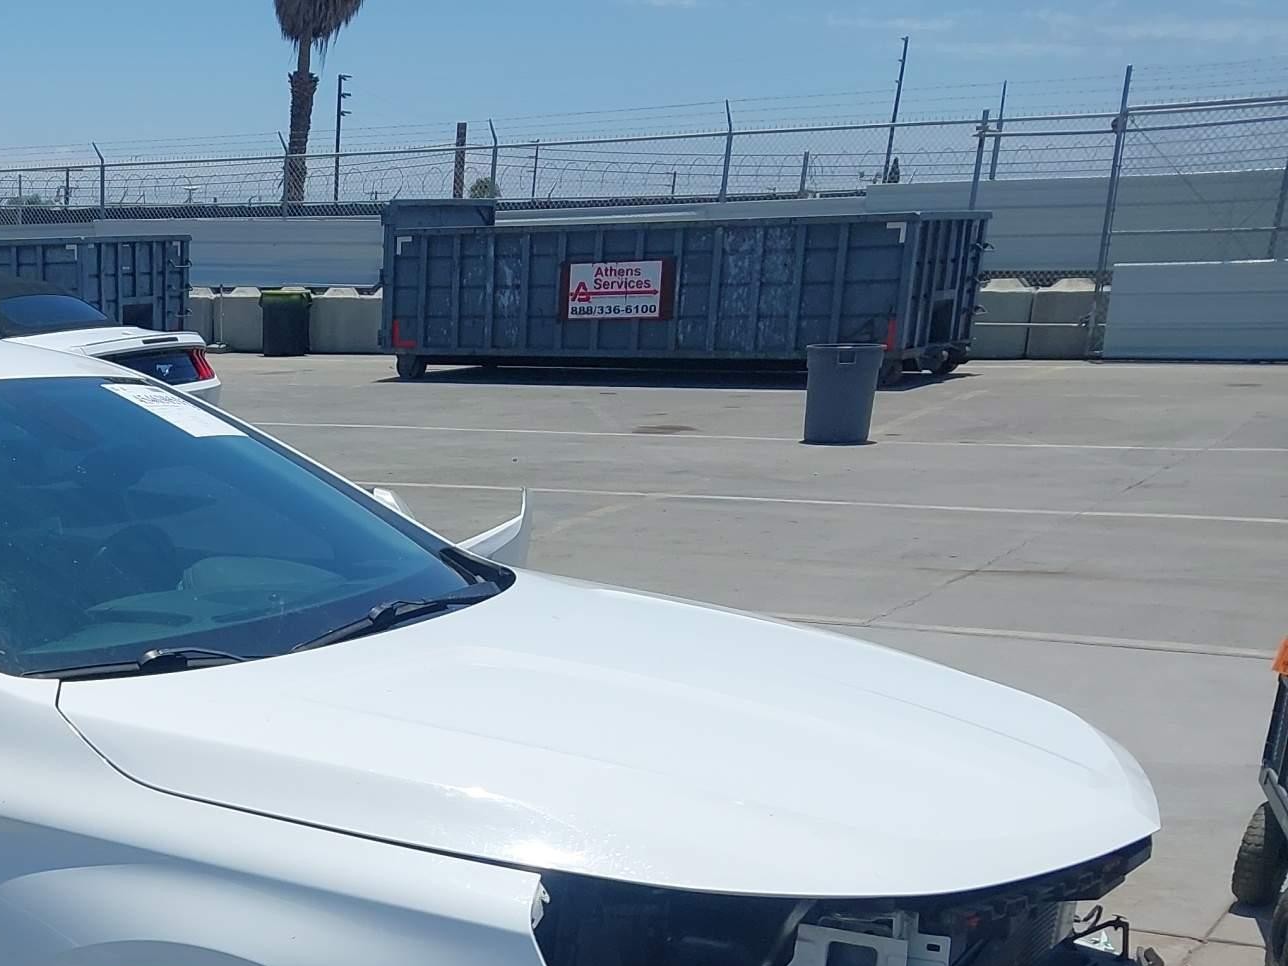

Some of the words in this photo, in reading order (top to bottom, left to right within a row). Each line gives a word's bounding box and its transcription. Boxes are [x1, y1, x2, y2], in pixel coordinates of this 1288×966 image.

[594, 266, 642, 278] Athens
[593, 278, 652, 291] Services
[570, 304, 657, 316] 888/336-6100
